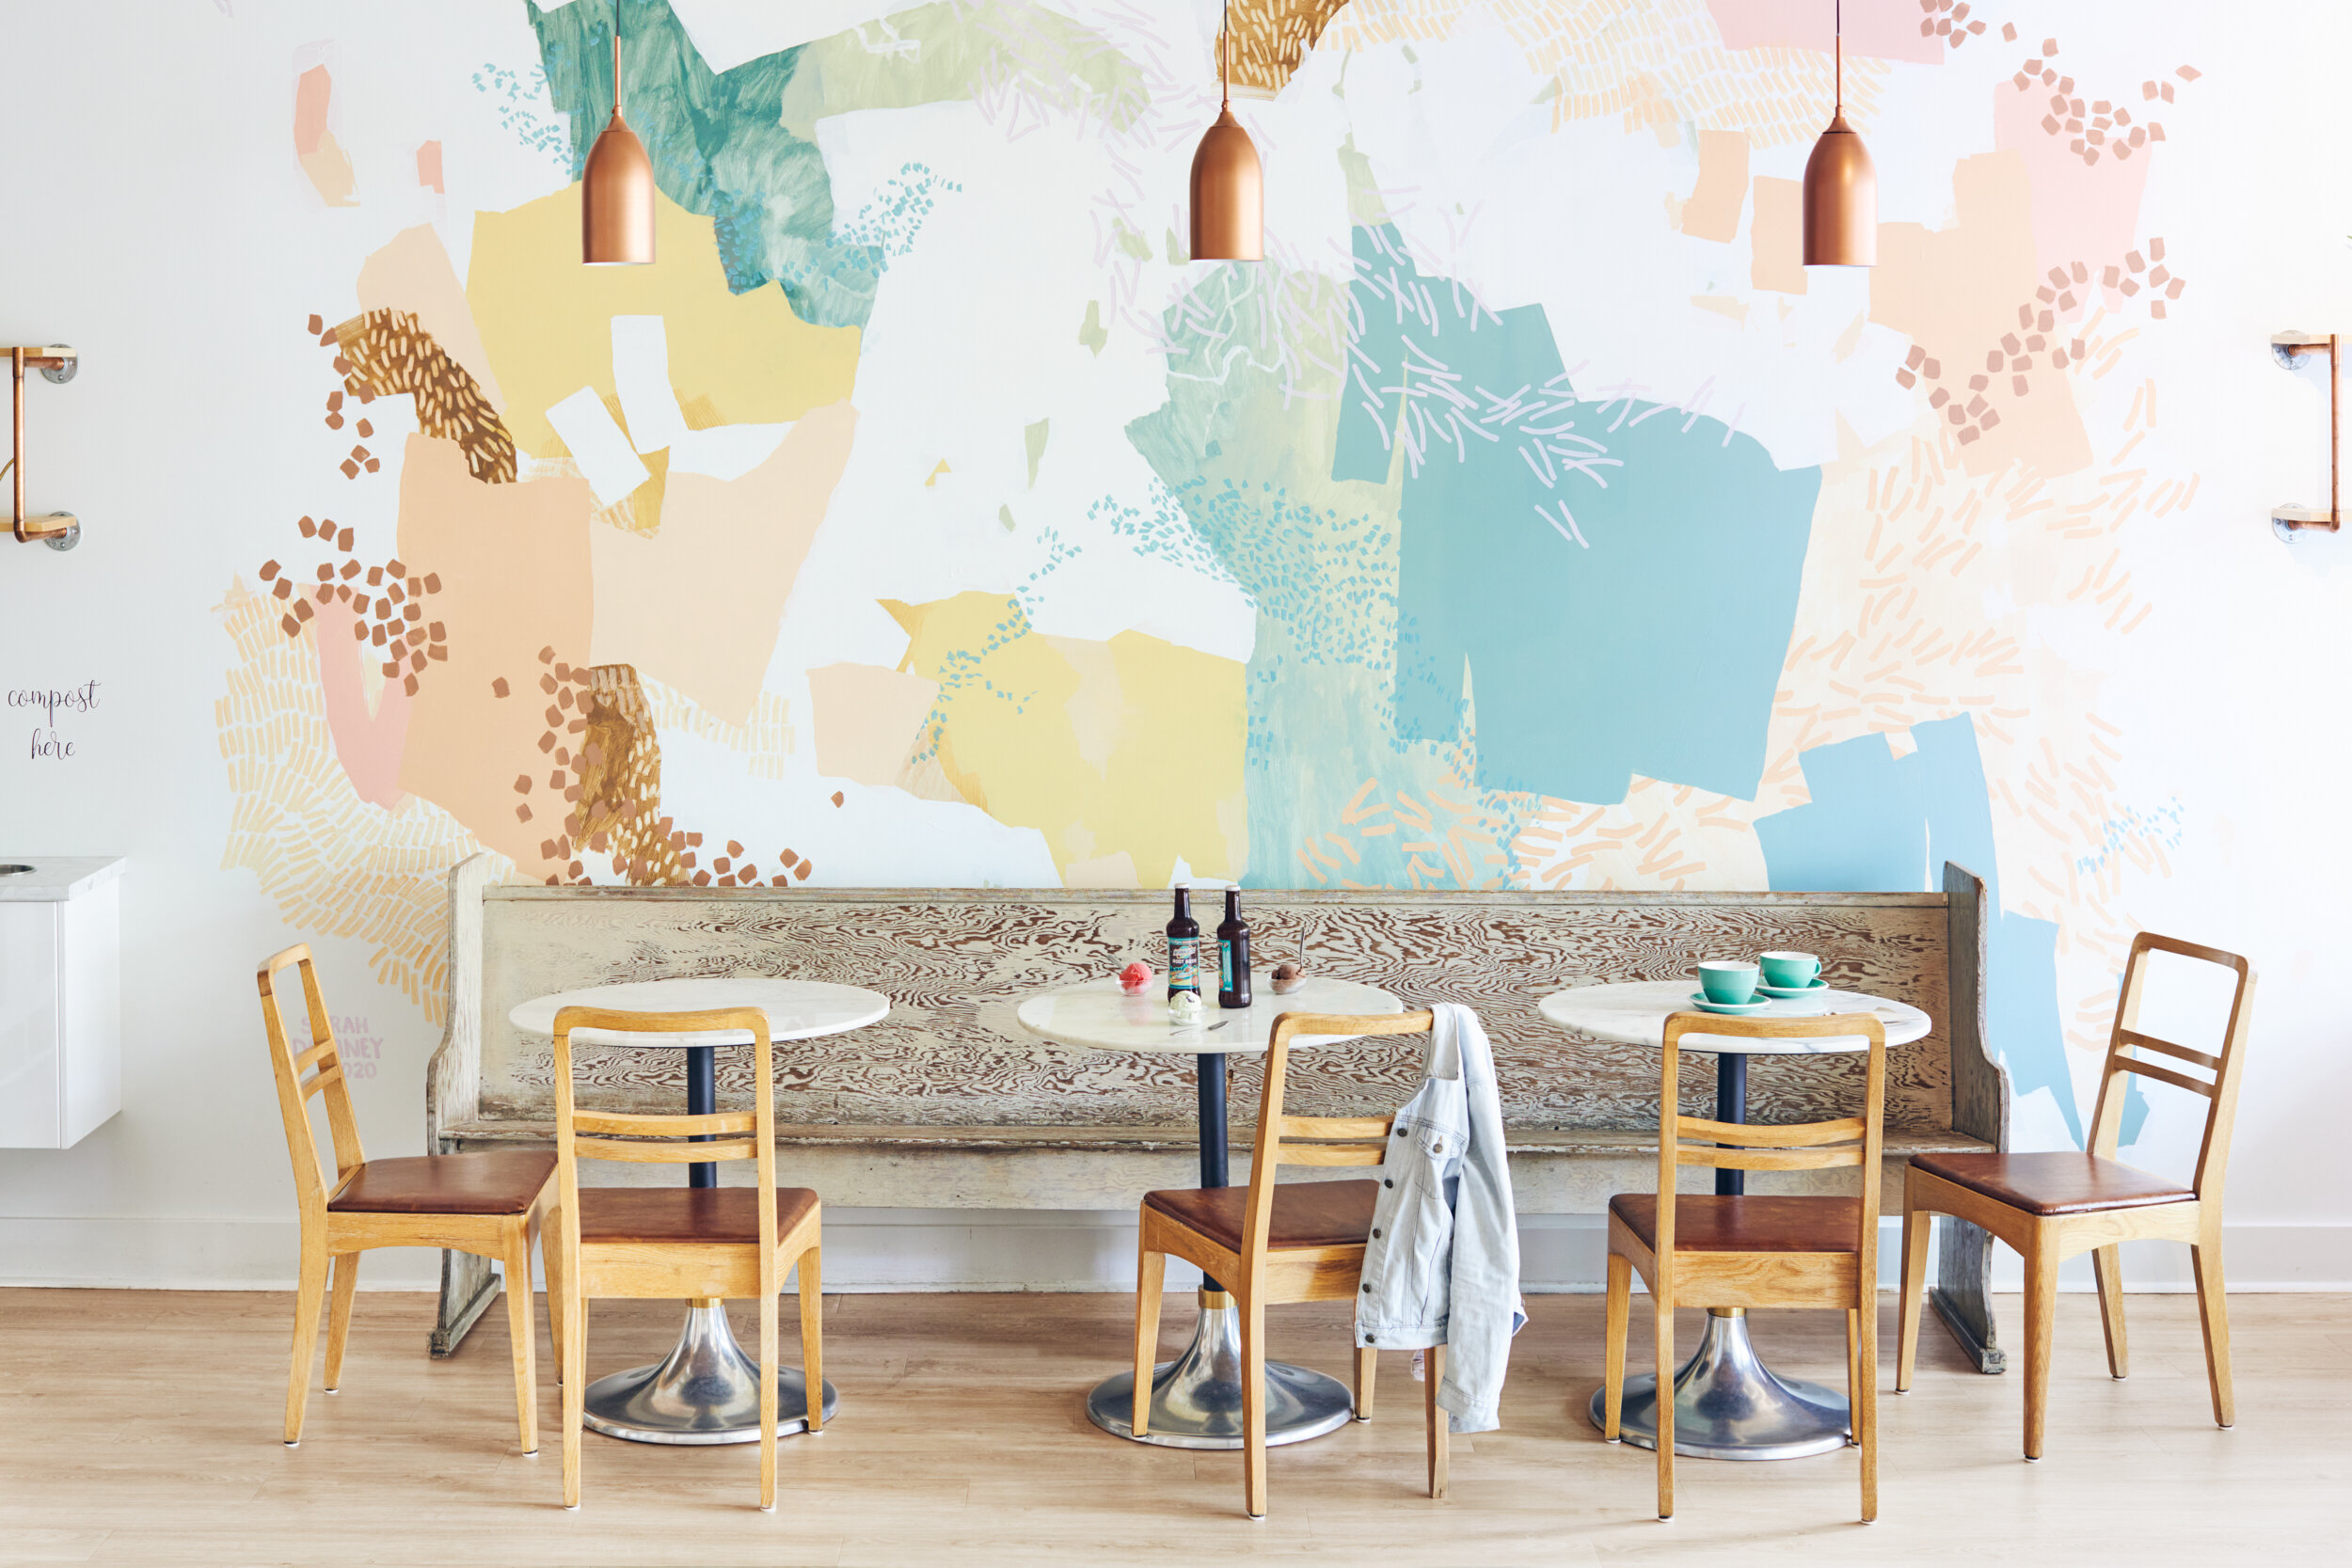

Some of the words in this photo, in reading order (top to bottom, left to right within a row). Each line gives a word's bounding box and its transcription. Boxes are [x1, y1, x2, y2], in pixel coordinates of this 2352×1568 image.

[8, 679, 102, 728] compost
[31, 727, 76, 760] here
[300, 1016, 369, 1035] SRAH
[292, 1037, 384, 1059] DNEY
[342, 1062, 377, 1079] 020
